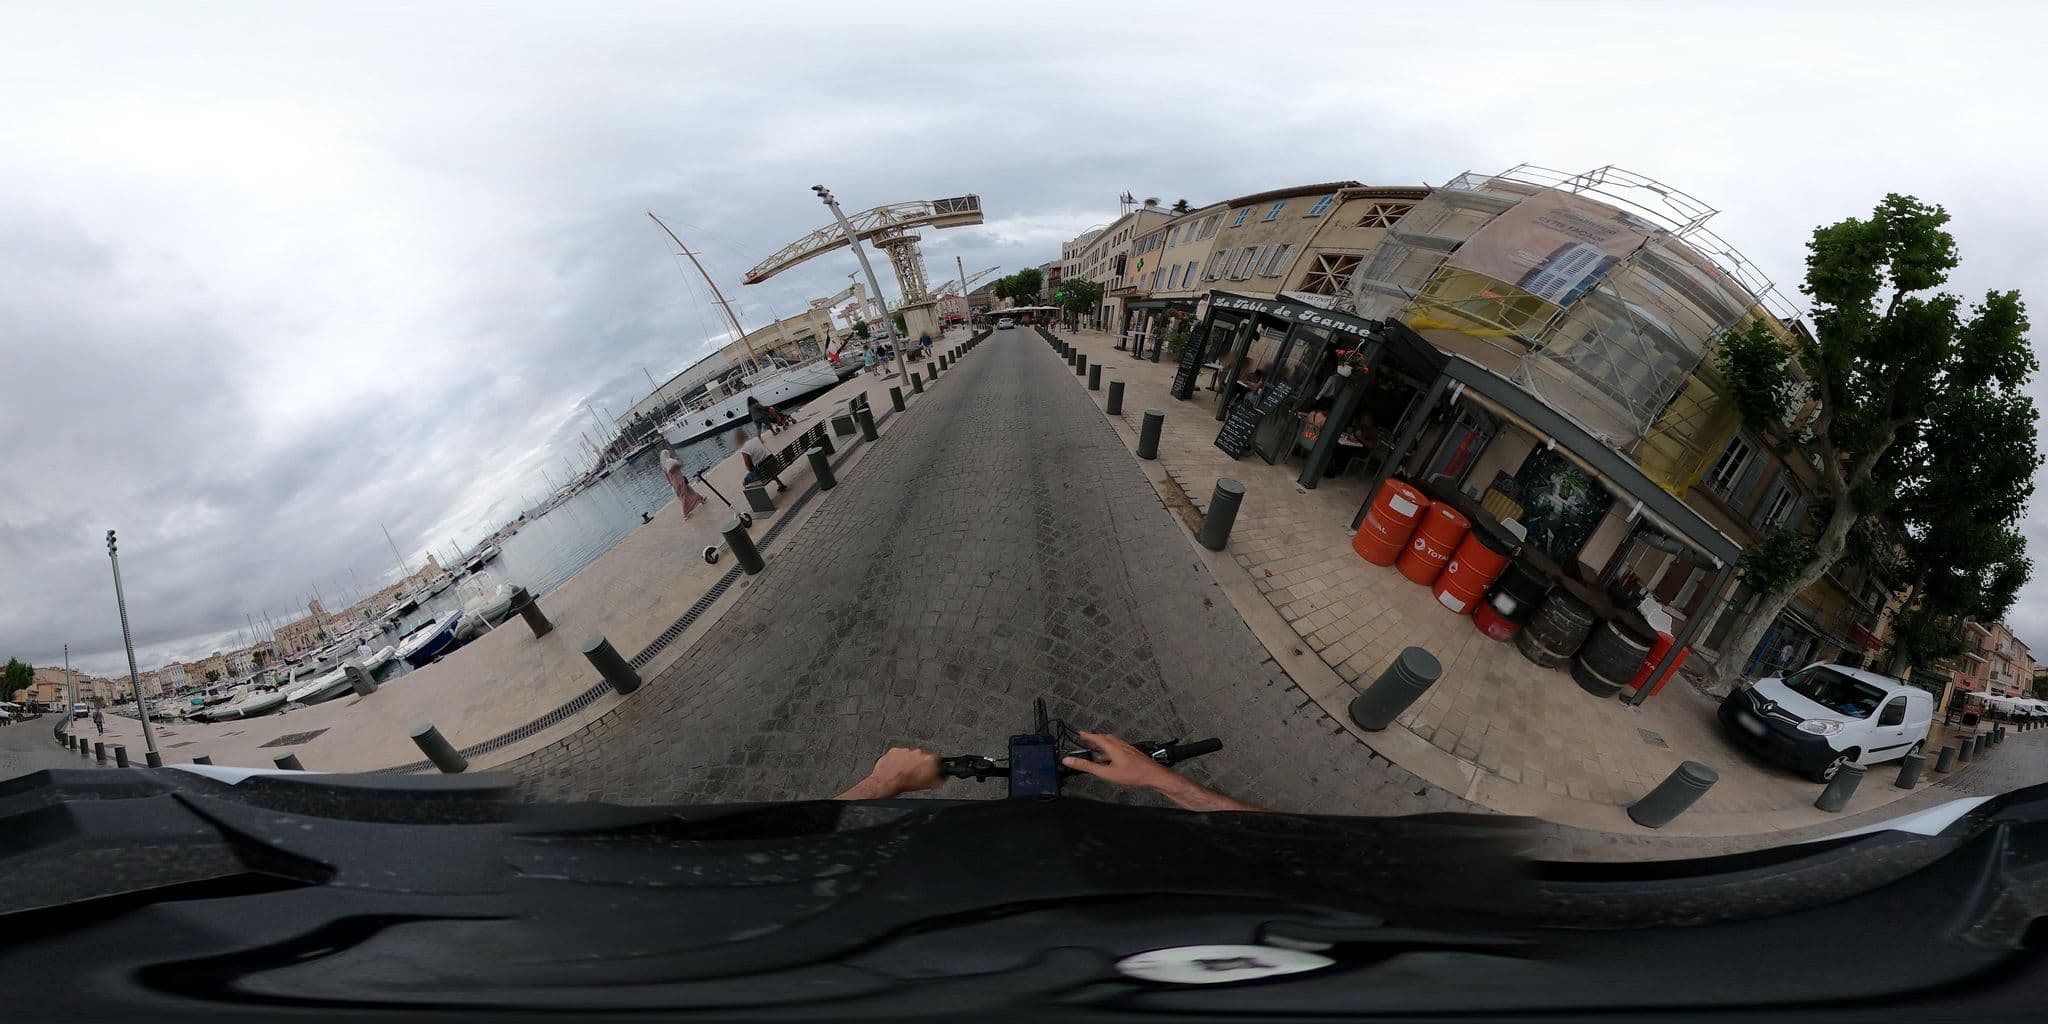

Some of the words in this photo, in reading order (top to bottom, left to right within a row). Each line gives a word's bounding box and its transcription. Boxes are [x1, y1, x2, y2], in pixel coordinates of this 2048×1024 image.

[1213, 297, 1230, 308] La
[1232, 299, 1268, 313] Table
[1273, 305, 1291, 317] de
[1298, 309, 1371, 338] Jeanne
